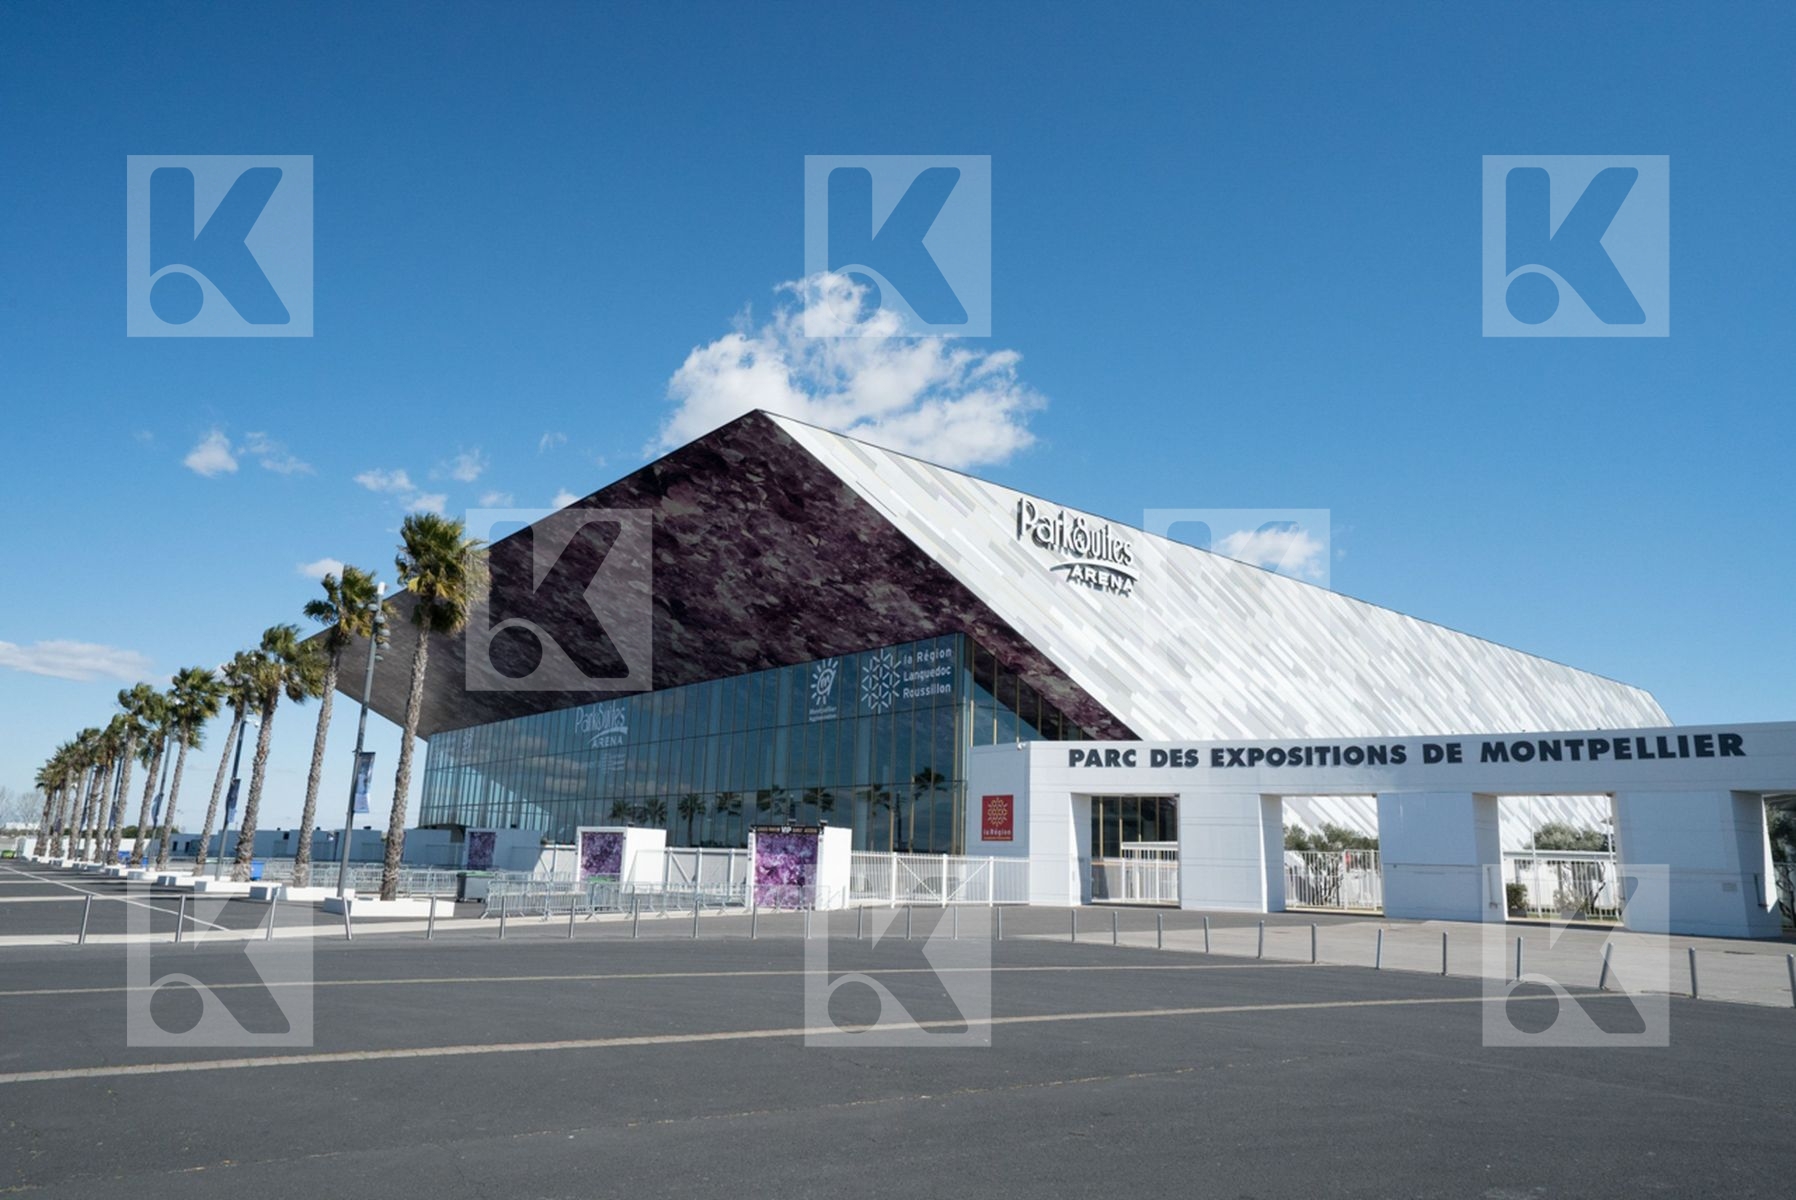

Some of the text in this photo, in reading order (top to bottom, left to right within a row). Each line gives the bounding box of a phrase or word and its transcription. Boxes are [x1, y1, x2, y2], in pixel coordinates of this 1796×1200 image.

[1067, 564, 1133, 596] ARENA
[917, 647, 952, 662] Région
[903, 665, 951, 682] Languedoc
[903, 683, 951, 699] Roussillon
[591, 735, 623, 749] ARENA
[1068, 732, 1747, 769] PARC DES EXPOSITIONS DE MONTPELLIER
